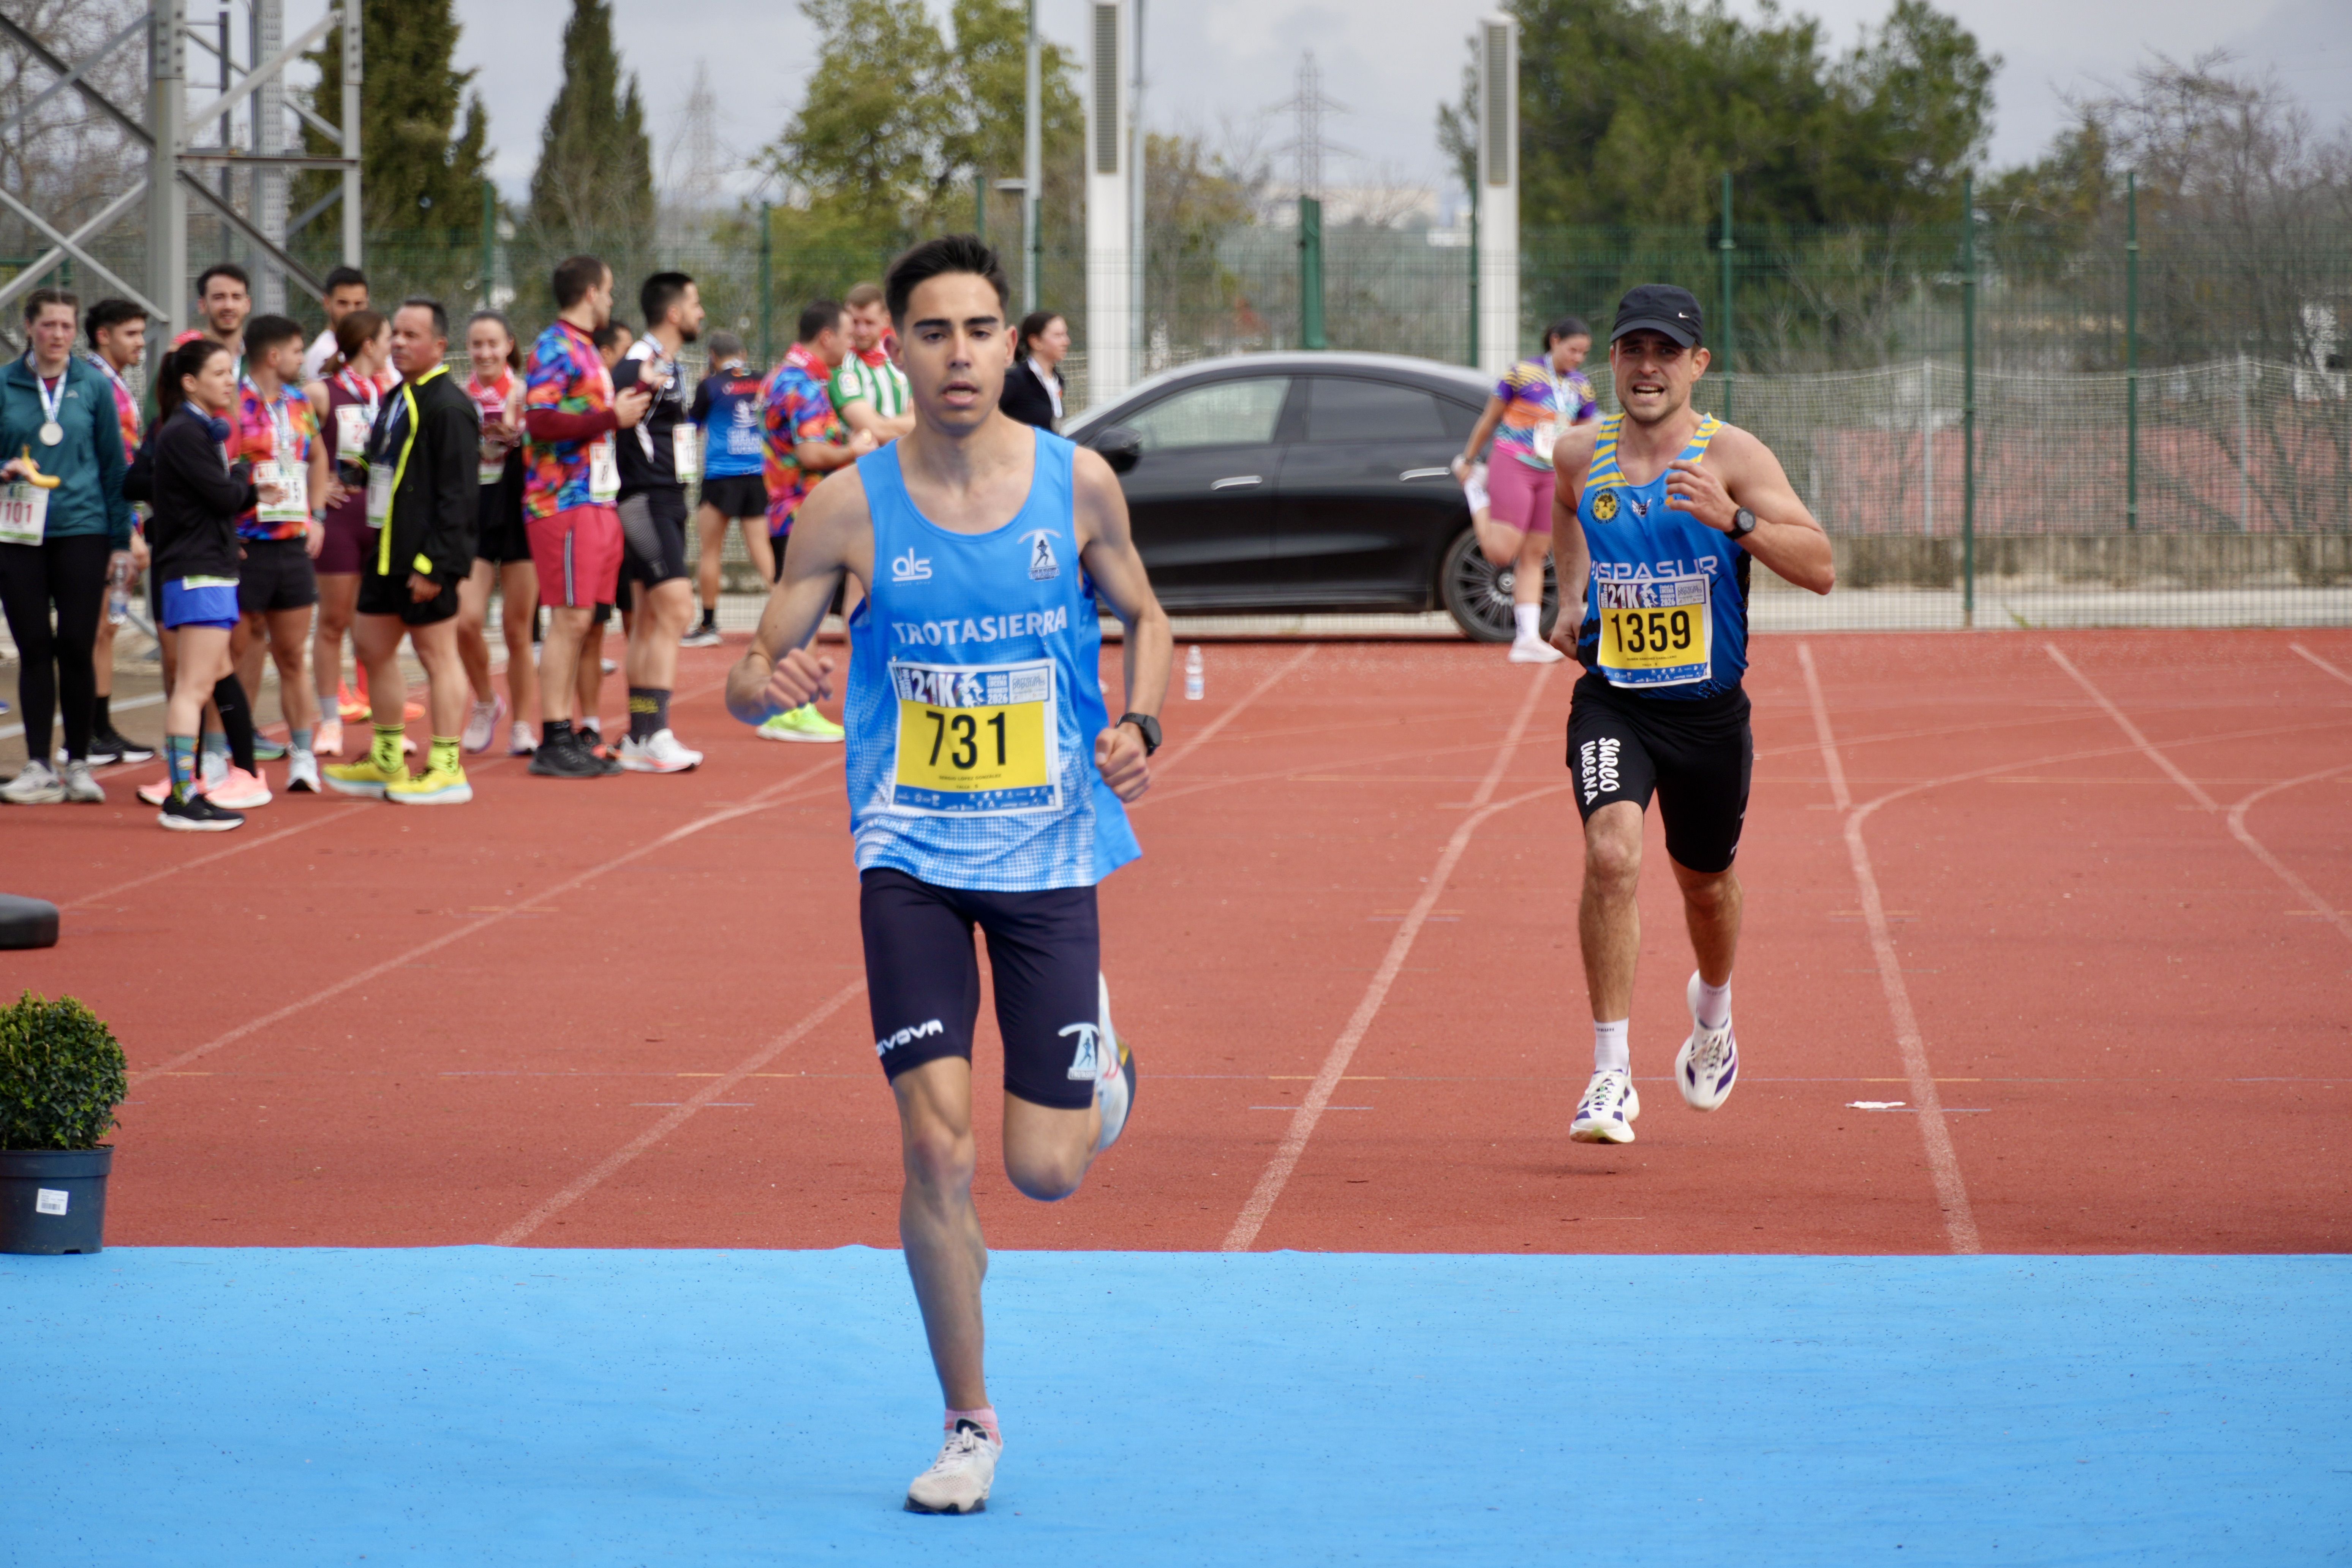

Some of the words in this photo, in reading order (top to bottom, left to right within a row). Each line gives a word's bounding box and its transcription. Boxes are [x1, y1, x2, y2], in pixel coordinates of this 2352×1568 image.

[1608, 584, 1640, 609] 21K
[1661, 598, 1676, 607] 2026
[891, 605, 1067, 646] TROTASIERRA
[1611, 610, 1691, 653] 1359
[912, 670, 956, 707] 21K
[1012, 675, 1040, 684] carreras
[1012, 680, 1045, 690] populares
[988, 693, 1008, 704] 2026
[925, 711, 1006, 770] 731
[1598, 737, 1621, 792] SURCO
